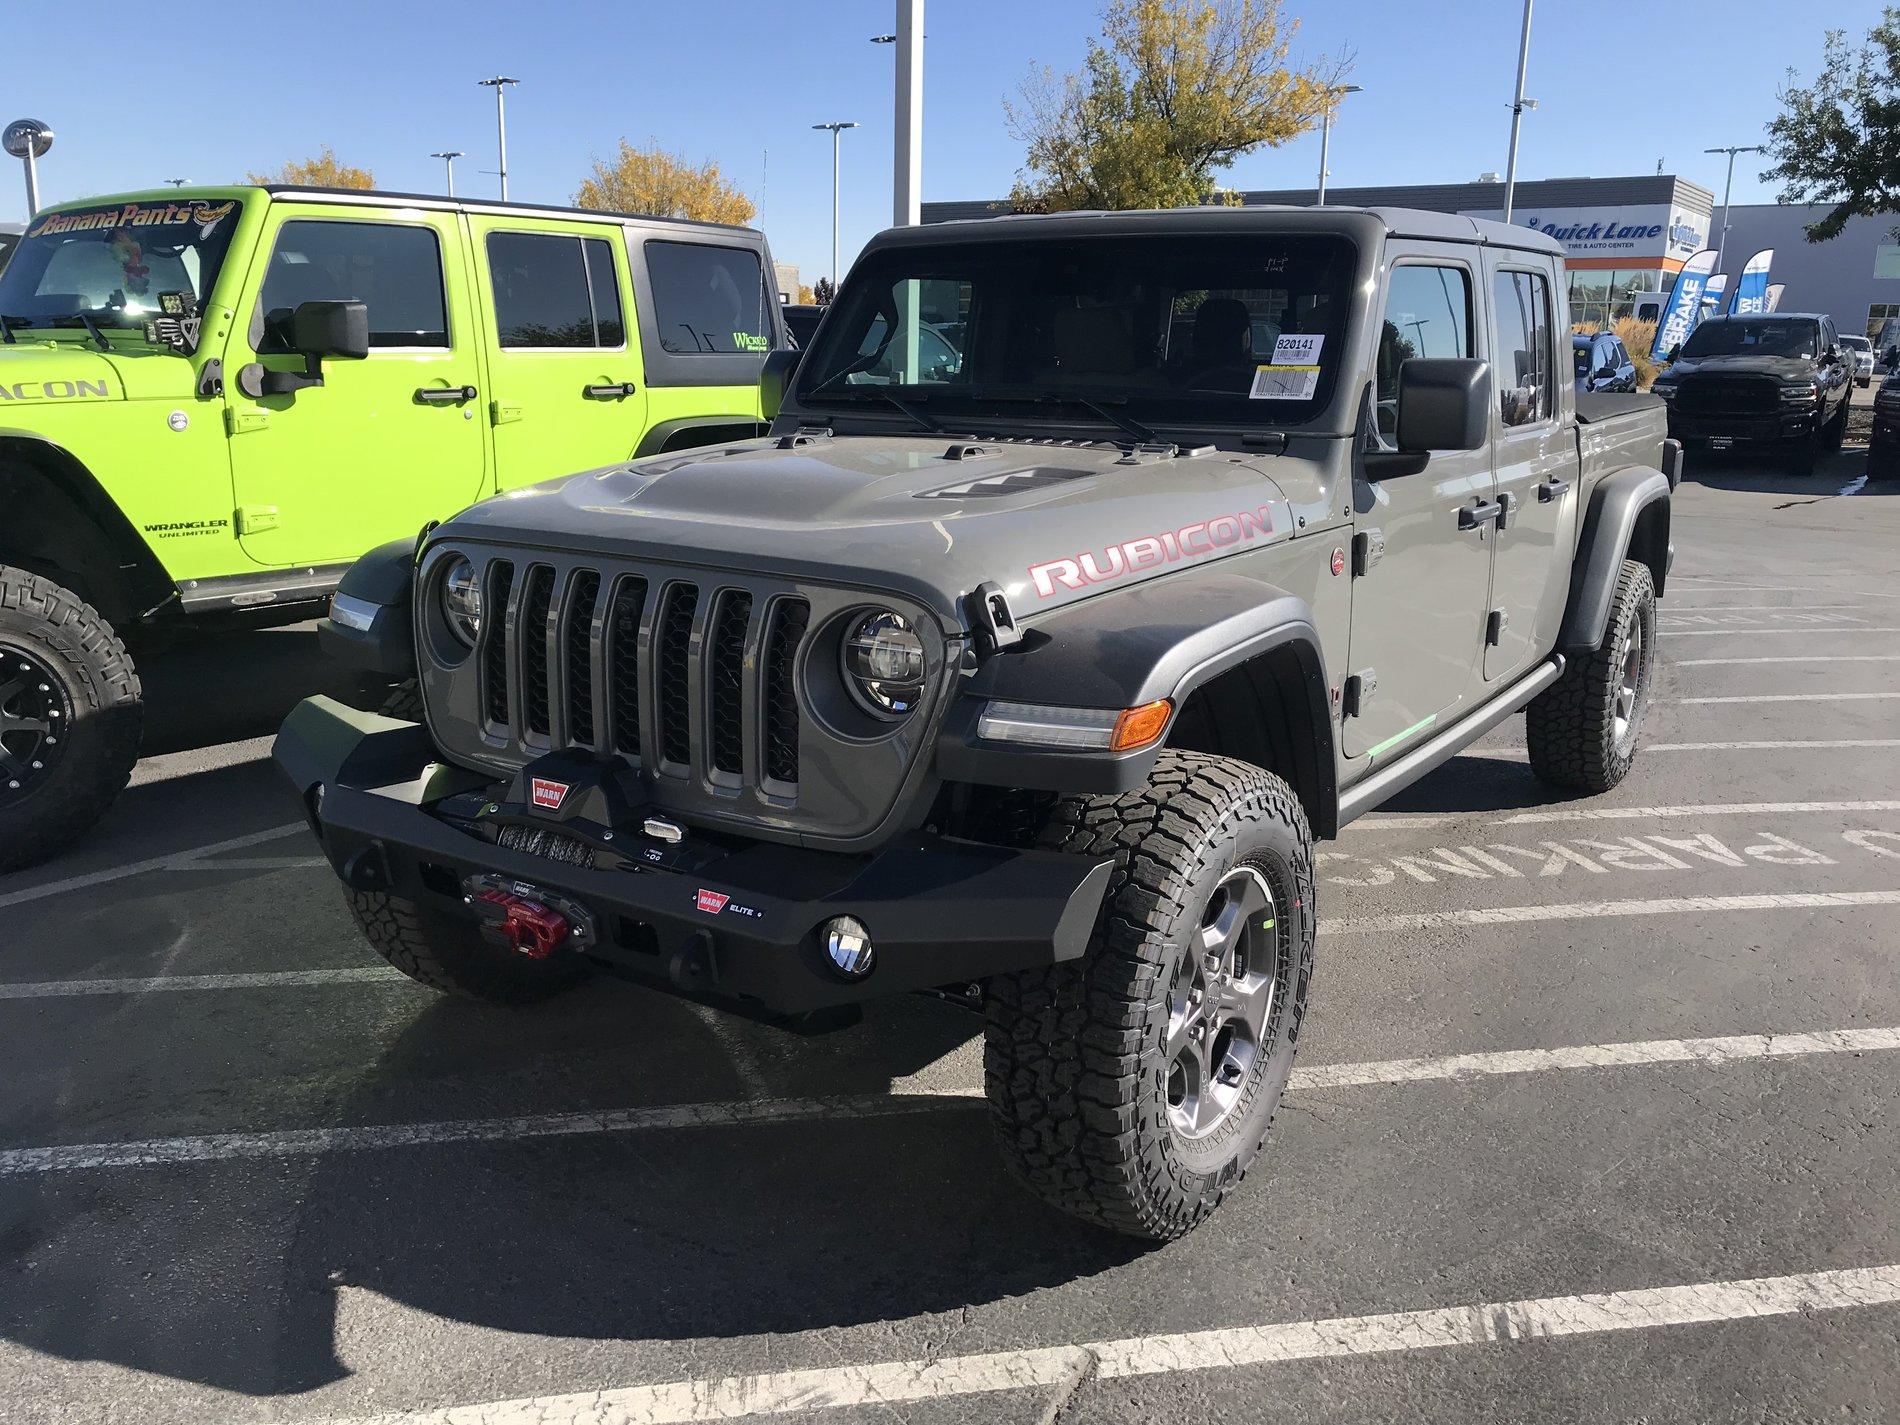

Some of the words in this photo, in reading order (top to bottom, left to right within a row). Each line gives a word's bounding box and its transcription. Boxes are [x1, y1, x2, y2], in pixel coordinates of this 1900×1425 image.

[29, 210, 119, 238] Banana
[118, 203, 192, 228] Pants
[1541, 222, 1602, 240] Quick
[1603, 221, 1662, 239] Lane
[1668, 279, 1699, 342] BRAKE
[1277, 339, 1314, 350] 820141
[144, 520, 228, 531] WRANGLER
[159, 529, 219, 539] UNLIMITED
[1027, 505, 1274, 598] RUBICON
[536, 786, 561, 801] WARN
[1317, 831, 1840, 886] PARKING
[700, 896, 723, 909] WARN
[730, 904, 754, 916] ELITE
